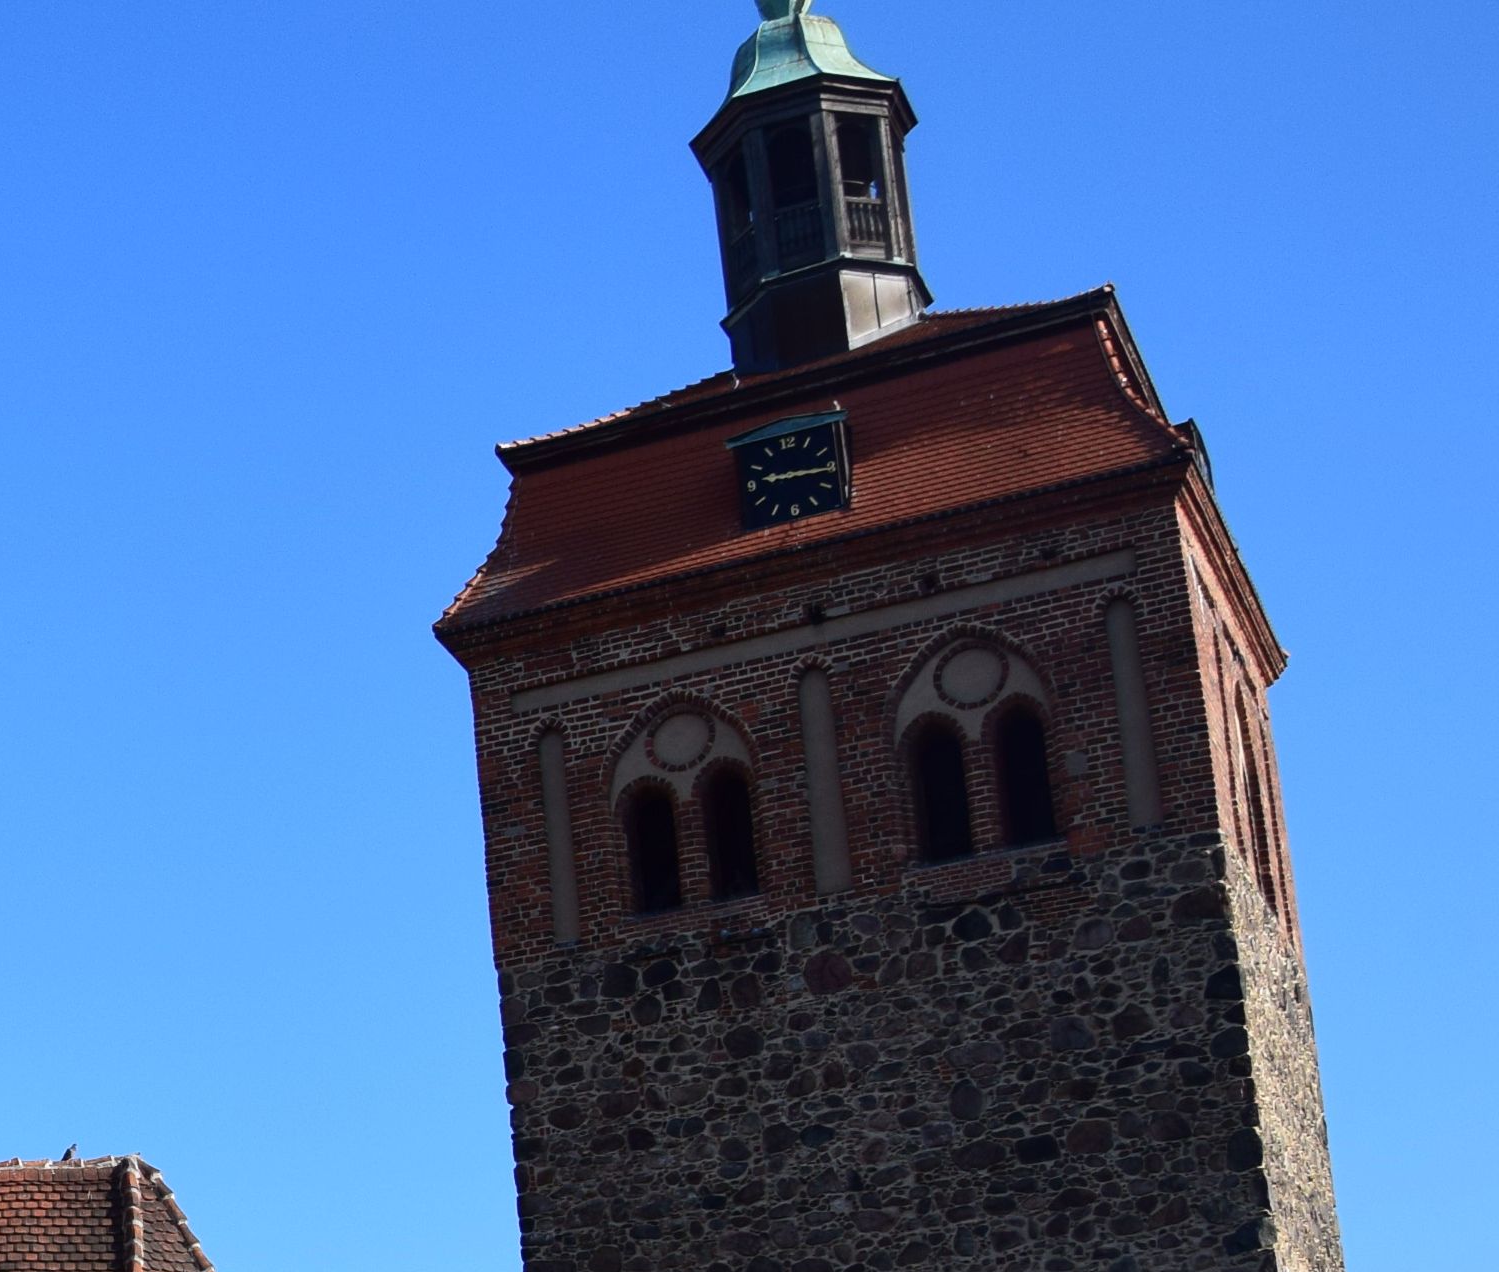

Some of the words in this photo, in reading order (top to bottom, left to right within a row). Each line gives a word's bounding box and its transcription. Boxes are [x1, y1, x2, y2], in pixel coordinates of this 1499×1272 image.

[779, 436, 796, 450] 12
[747, 480, 757, 492] 9
[790, 504, 800, 516] 6
